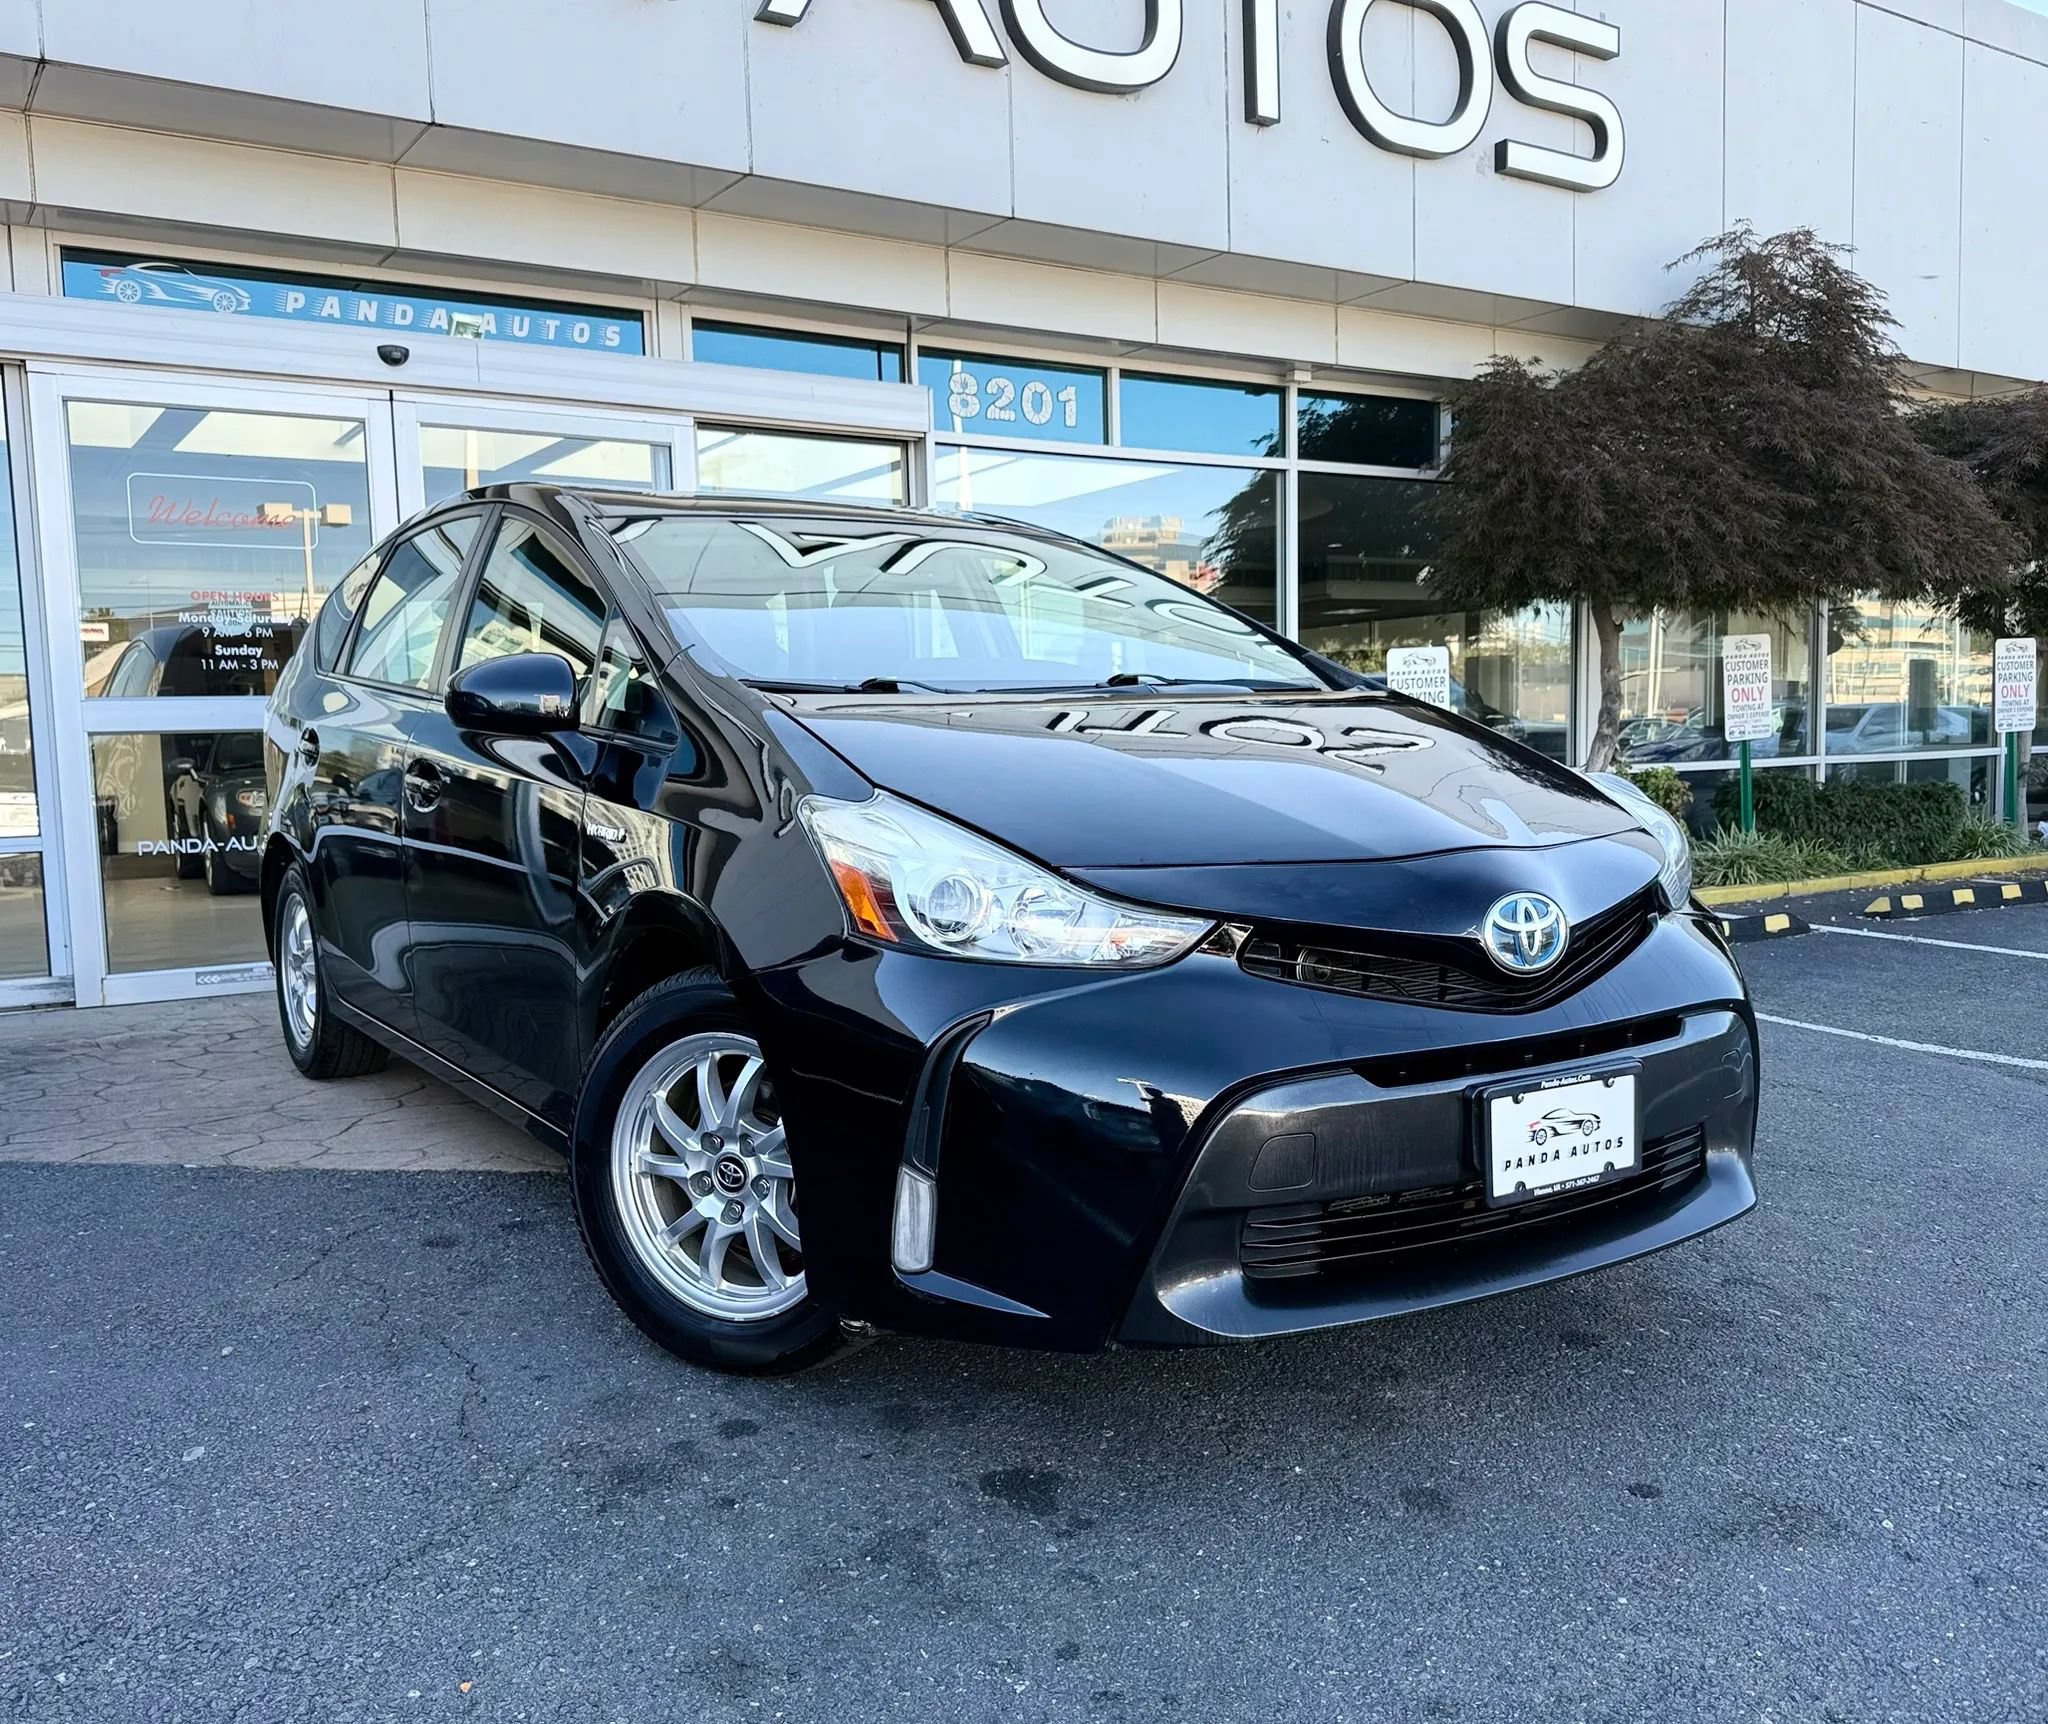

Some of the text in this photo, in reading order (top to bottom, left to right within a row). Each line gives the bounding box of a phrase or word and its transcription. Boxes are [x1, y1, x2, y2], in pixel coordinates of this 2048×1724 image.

[284, 290, 621, 347] PANDA AUTOS
[949, 372, 1077, 428] 8201
[149, 495, 297, 528] Welcome
[190, 590, 228, 601] OPEN
[179, 612, 294, 626] Monday-Satury
[202, 627, 210, 638] 9
[256, 628, 274, 638] PM
[215, 644, 263, 658] Sunday
[201, 659, 214, 670] 11
[219, 660, 238, 670] AM
[250, 660, 258, 670] 3
[261, 660, 279, 670] PM
[1725, 659, 1769, 672] CUSTOMER
[1997, 660, 2034, 671] CUSTOMER
[1390, 676, 1446, 690] CUSTOMER
[1727, 672, 1768, 686] PARKING
[1998, 671, 2033, 683] PARKING
[1408, 690, 1445, 704] KING
[1731, 686, 1765, 703] ONLY
[2001, 684, 2030, 699] ONLY
[1504, 1137, 1624, 1171] PANDA AUTOS
